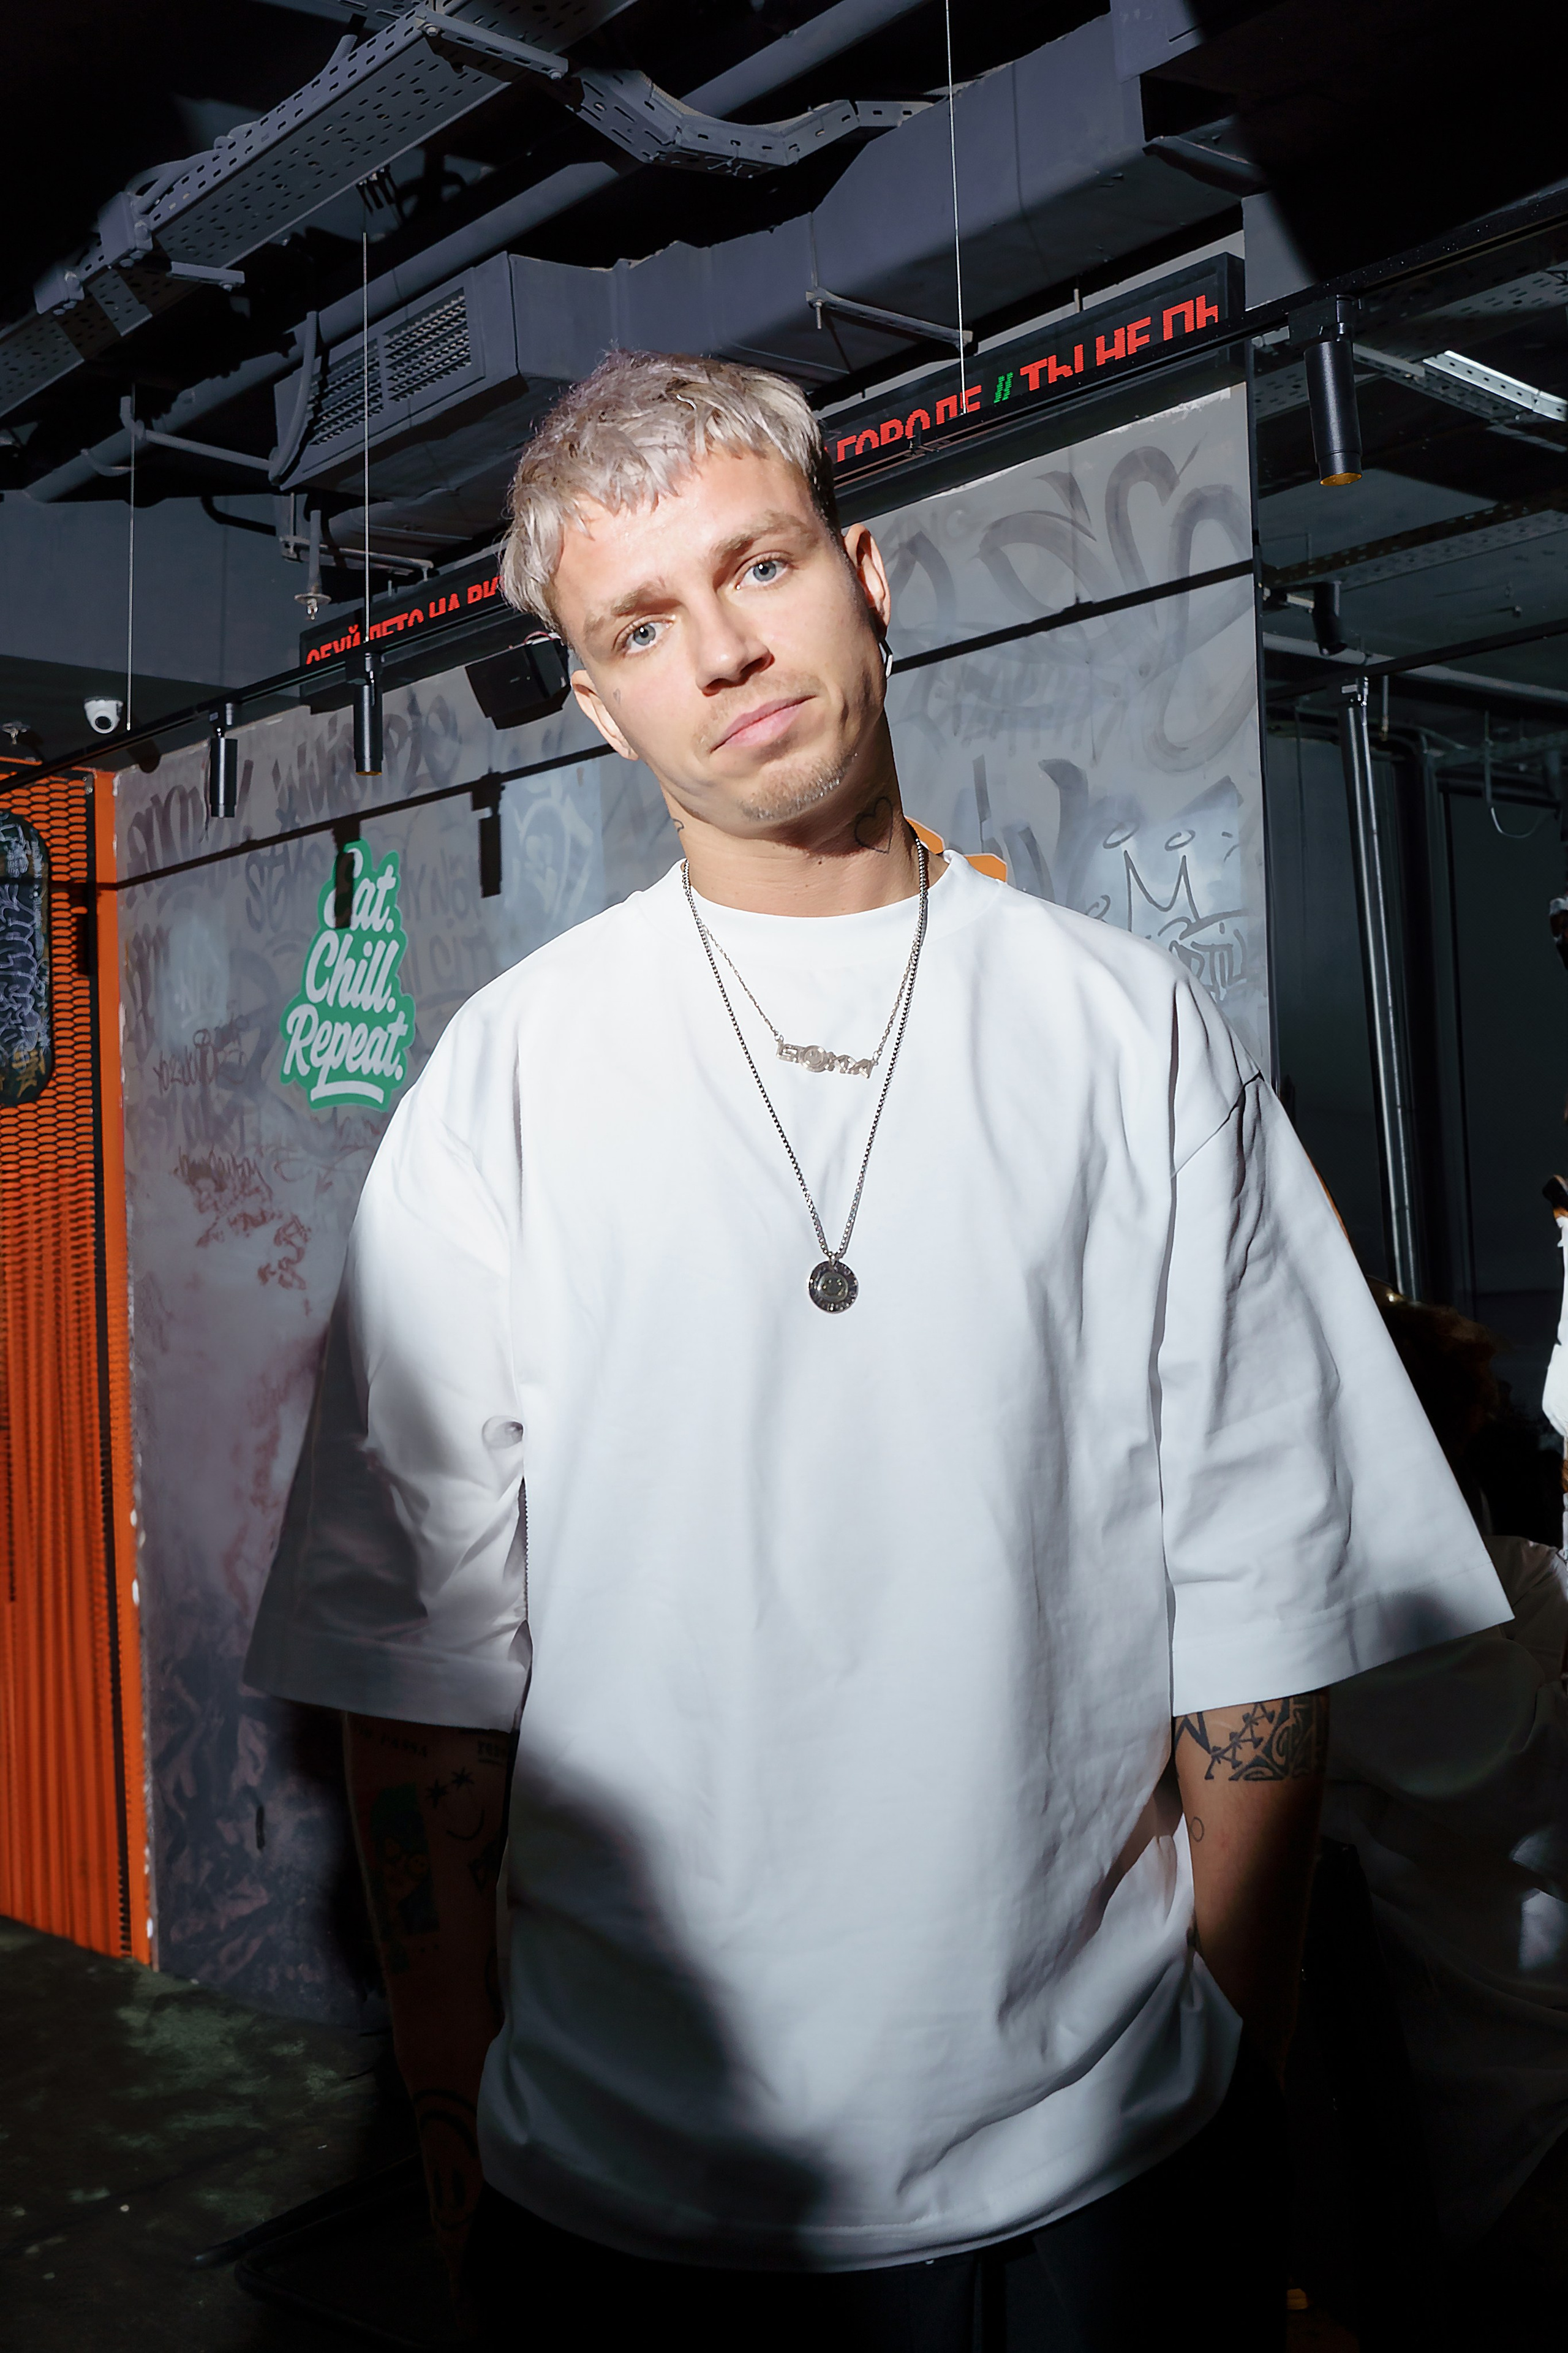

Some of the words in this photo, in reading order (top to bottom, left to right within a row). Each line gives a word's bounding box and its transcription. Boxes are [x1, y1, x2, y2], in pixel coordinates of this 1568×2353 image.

[1095, 315, 1152, 367] НЕ
[305, 930, 400, 1013] Chill.
[283, 1003, 409, 1103] Repeat.
